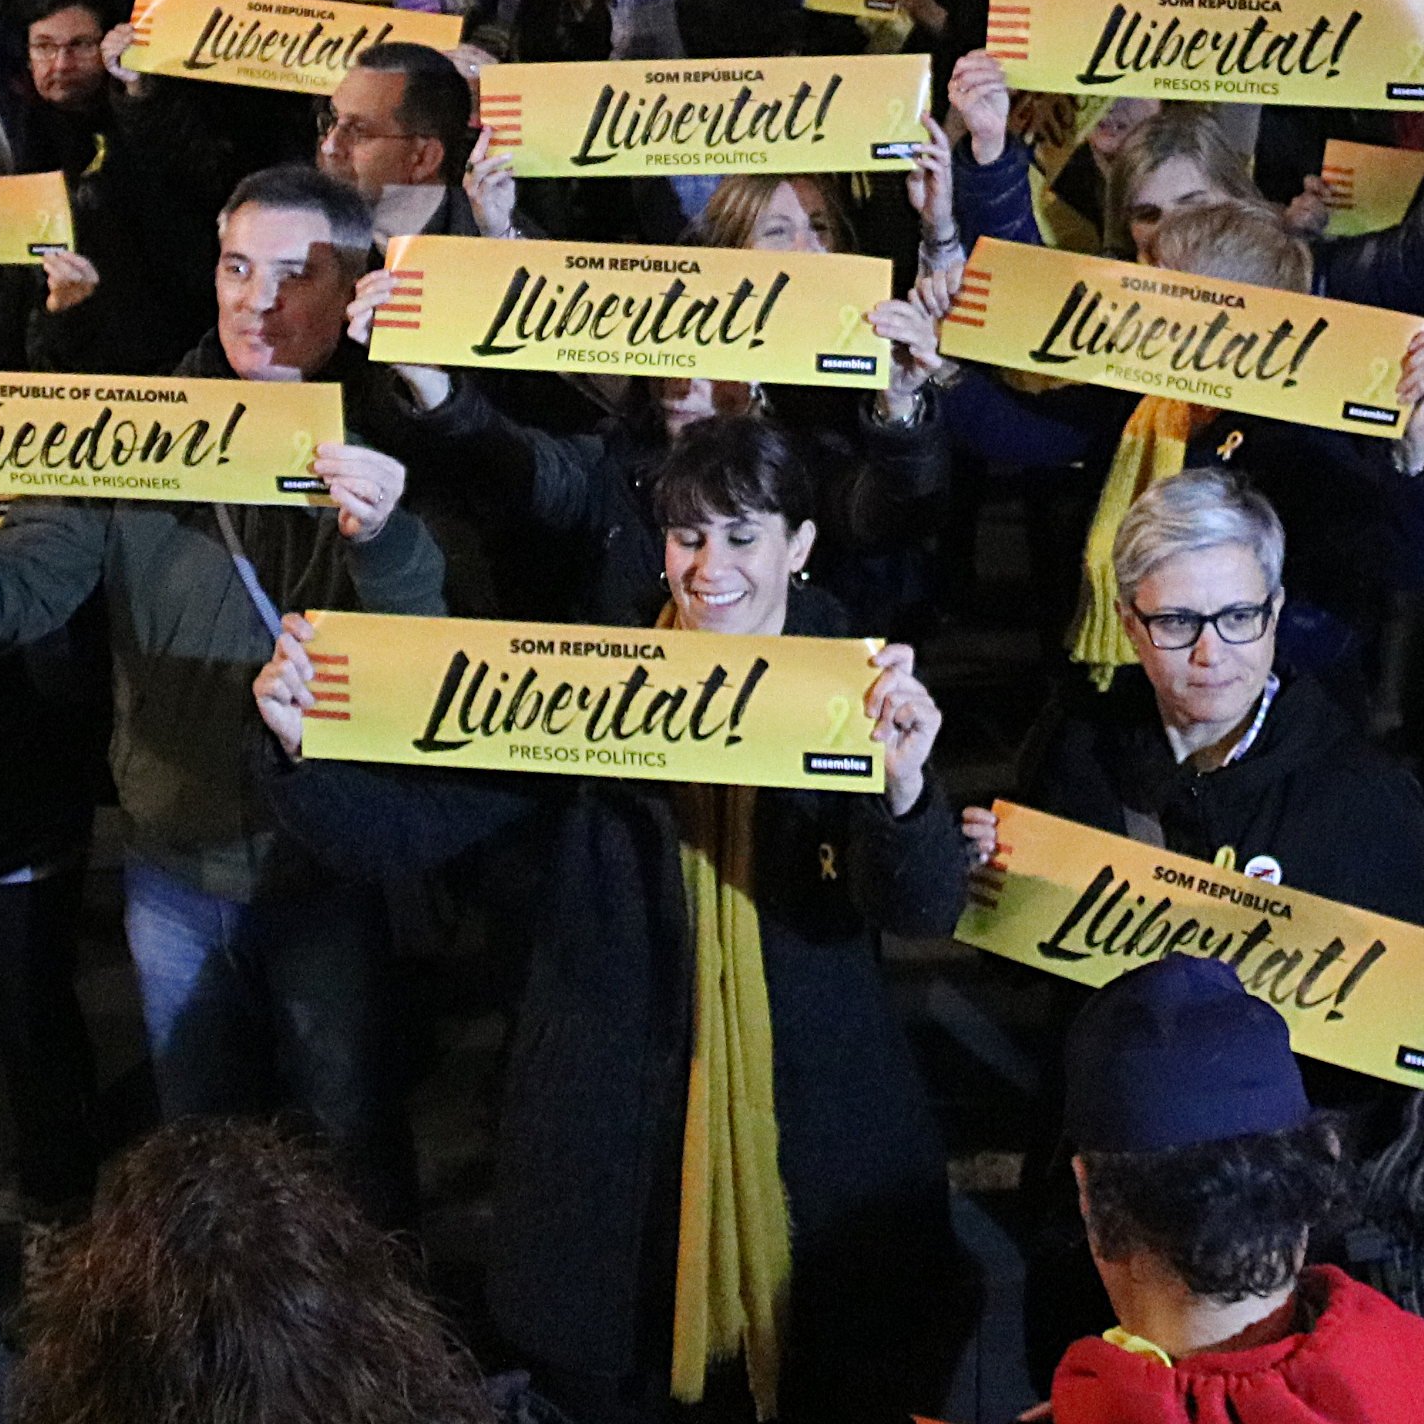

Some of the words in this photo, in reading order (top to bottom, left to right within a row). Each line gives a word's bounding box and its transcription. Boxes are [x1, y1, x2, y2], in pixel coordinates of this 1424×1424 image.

[1077, 6, 1364, 84] Llibertat!
[645, 71, 681, 84] SOM
[684, 69, 764, 84] REPÚBLICA
[1153, 77, 1211, 92] PRESOS
[1216, 79, 1280, 95] POLÍTICS
[571, 75, 842, 167] Llibertat!
[645, 152, 699, 166] PRESOS
[704, 150, 767, 165] POLÍTICS
[565, 257, 605, 271] SOM
[608, 257, 701, 274] REPÚBLICA
[1120, 277, 1158, 293] SOM
[1160, 281, 1246, 310] REPÚBLICA
[473, 268, 788, 356] Llibertat!
[1030, 281, 1327, 388] Llibertat!
[557, 349, 619, 364] PRESOS
[624, 351, 697, 369] POLÍTICS
[70, 387, 92, 402] OF
[95, 387, 188, 405] CATALONIA
[10, 472, 89, 489] POLITICAL
[93, 474, 181, 491] PRISONERS
[509, 638, 556, 656] SOM
[561, 639, 666, 661] REPÚBLICA
[414, 651, 768, 752] Llibertat!
[508, 744, 579, 763] PRESOS
[584, 747, 668, 768] POLÍTICS
[1153, 865, 1195, 891] SOM
[1197, 878, 1293, 921] REPÚBLICA
